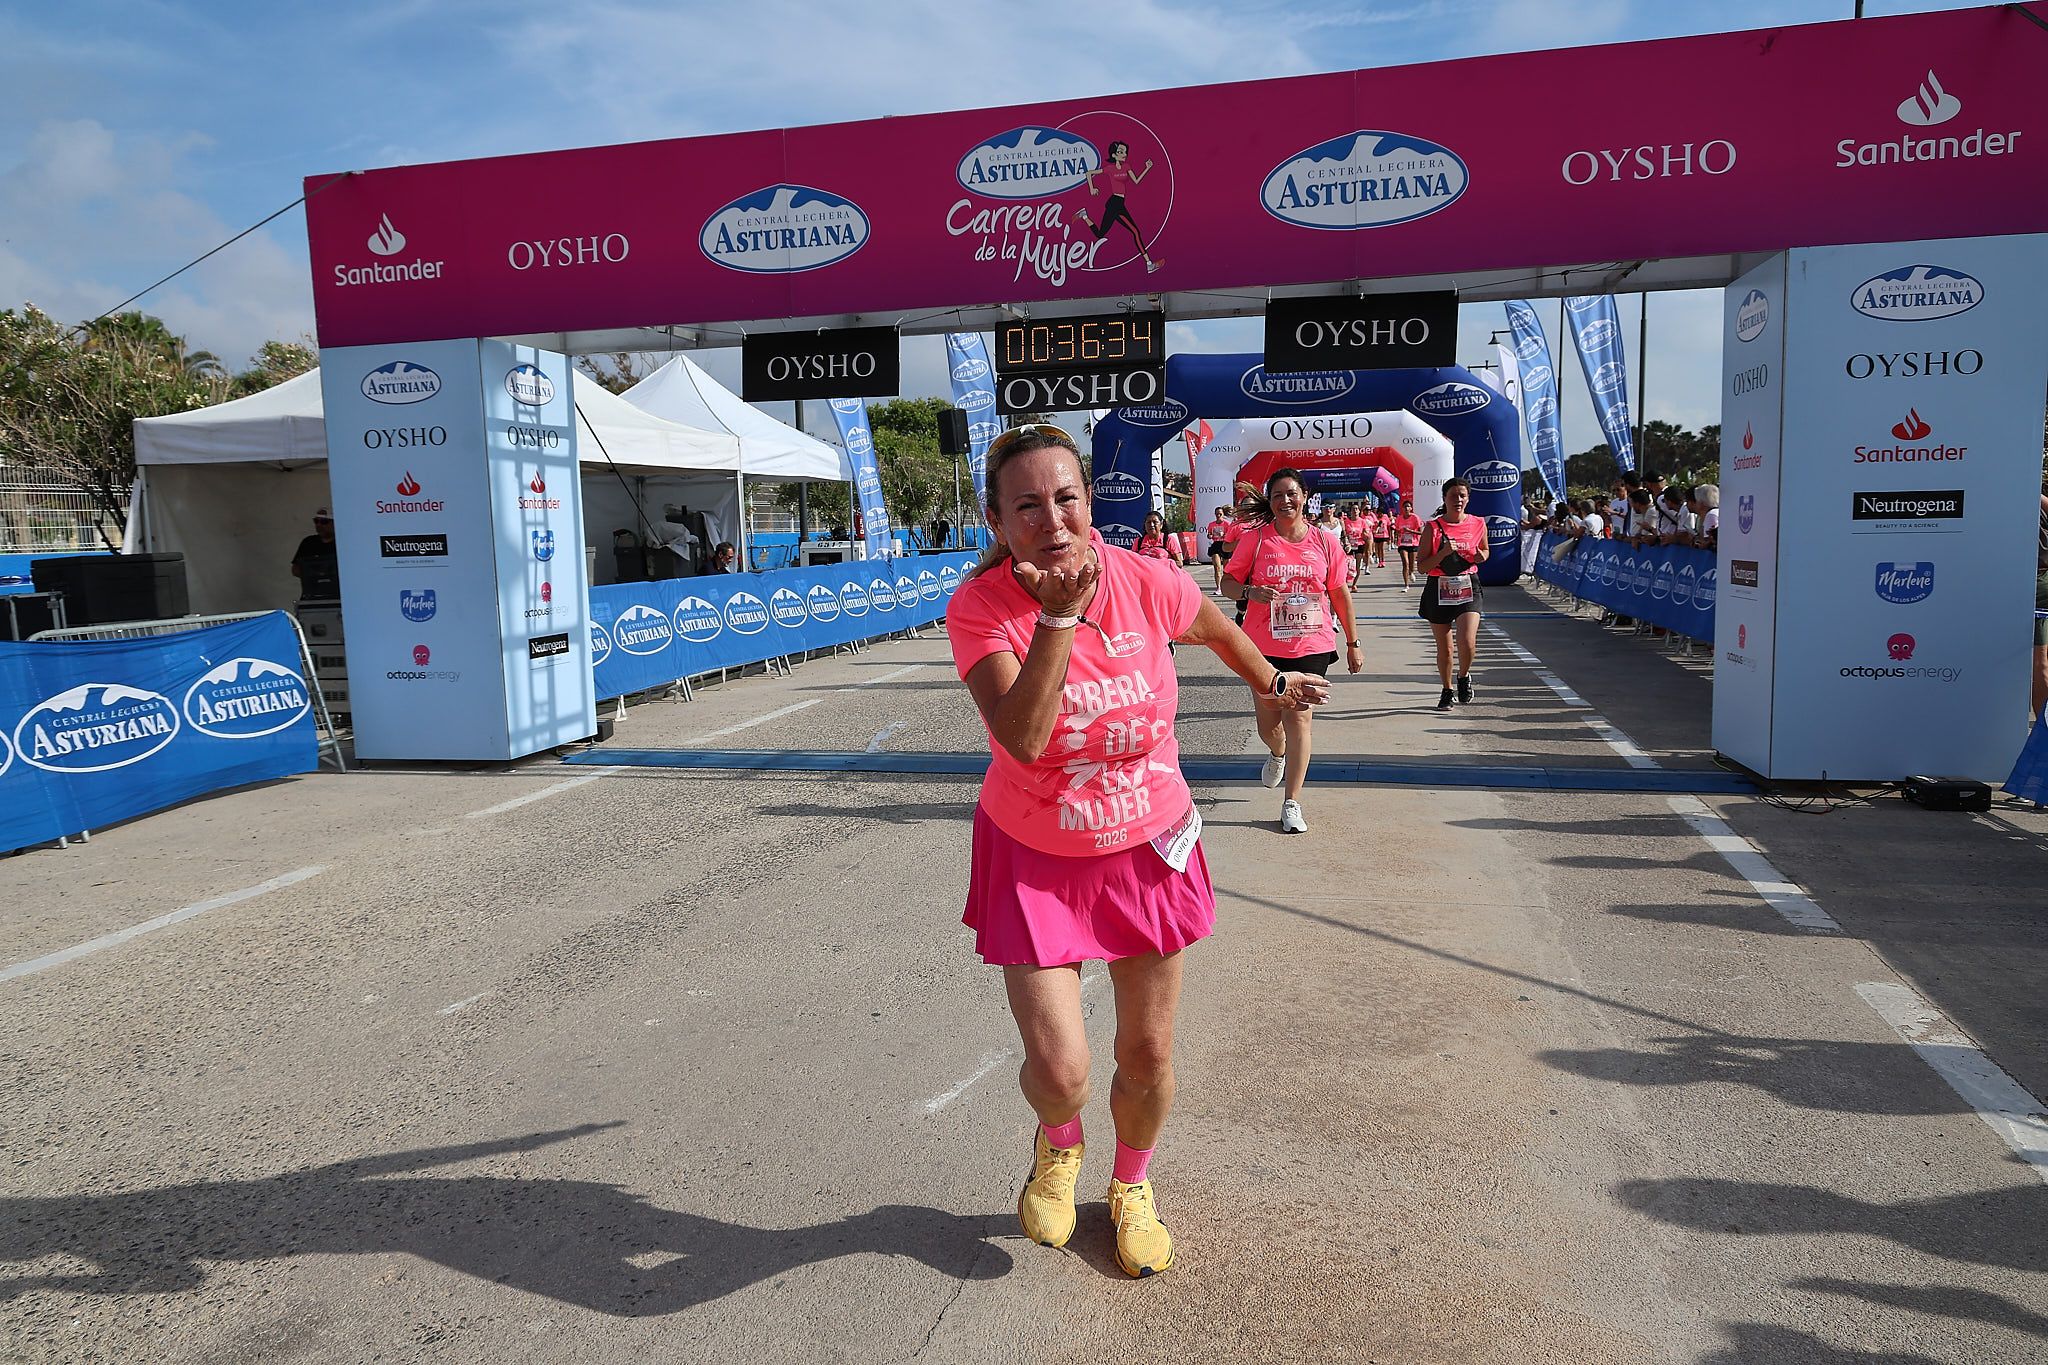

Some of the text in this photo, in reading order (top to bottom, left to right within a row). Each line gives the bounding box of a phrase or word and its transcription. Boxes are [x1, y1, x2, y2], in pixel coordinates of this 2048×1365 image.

[989, 146, 1085, 162] CENTRAL LECHERA
[1836, 128, 2022, 168] Santander
[968, 157, 1088, 185] ASTURIANA
[1308, 159, 1445, 179] CENTRAL LECHERA
[1562, 139, 1737, 185] OYSHO
[1276, 172, 1452, 209] ASTURIANA
[737, 211, 850, 227] CENTRAL LECHERA
[946, 199, 1063, 236] Carrera
[713, 222, 857, 254] ASTURIANA
[508, 233, 629, 270] OYSHO
[974, 226, 1109, 287] de la Mujer
[335, 259, 444, 287] Santander
[1859, 287, 1974, 309] ASTURIANA
[1006, 321, 1152, 365] 00:36:34
[1295, 318, 1430, 348] OYSHO
[767, 352, 876, 382] OYSHO
[1846, 349, 1984, 379] OYSHO
[368, 379, 436, 396] ASTURIANA
[508, 377, 552, 398] ASTURIANA
[1004, 370, 1157, 411] OYSHO
[1249, 373, 1347, 393] ASTURIANA
[1733, 363, 1768, 397] OYSHO
[1122, 407, 1182, 419] ASTURIANA
[1419, 395, 1486, 410] ASTURIANA
[364, 426, 447, 449] OYSHO
[507, 426, 559, 449] OYSHO
[1270, 417, 1372, 440] OYSHO
[1402, 436, 1434, 445] OYSHO
[1328, 447, 1375, 456] Santander
[1854, 443, 1968, 463] Santander
[1094, 483, 1140, 494] ASTURIANA
[1419, 479, 1446, 487] OYSH
[376, 499, 445, 514] Santander
[518, 496, 560, 510] Santander
[1860, 497, 1957, 516] Neutrogena
[385, 540, 443, 554] Neutrogena
[1267, 565, 1313, 578] CARRERA
[1878, 571, 1931, 594] Marlene
[402, 596, 435, 613] Marlene
[679, 616, 720, 633] ASTURIANA
[729, 608, 767, 626] ASTURIANA
[619, 624, 671, 647] ASTURIANA
[386, 670, 460, 682] octopus energy
[1840, 666, 1962, 682] octopus energy
[211, 678, 295, 698] CENTRAL LECHERA
[1060, 670, 1154, 715] RRERA
[198, 689, 305, 726] ASTURIANA
[52, 711, 106, 728] CENTRAL
[32, 713, 172, 760] ASTURIANA
[1104, 719, 1144, 755] DE
[1059, 787, 1151, 832] MUJER
[1095, 828, 1128, 848] 2026
